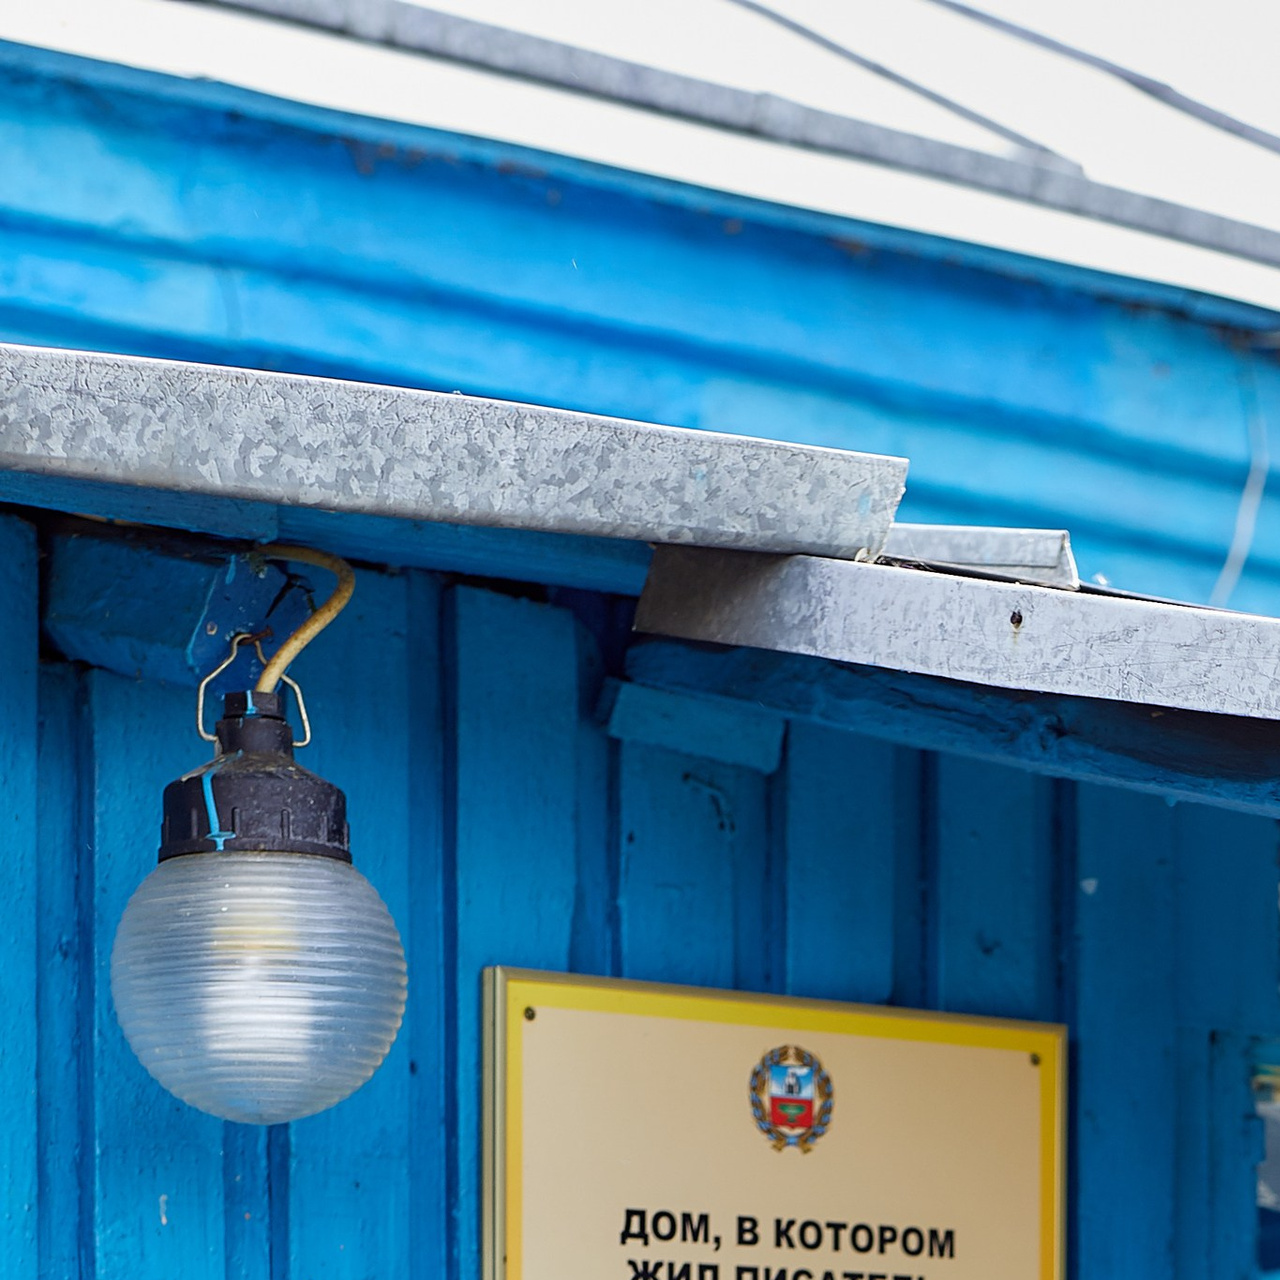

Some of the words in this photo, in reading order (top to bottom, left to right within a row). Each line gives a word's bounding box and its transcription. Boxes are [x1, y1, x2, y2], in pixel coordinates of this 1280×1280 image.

[620, 1208, 721, 1252] ДОМ,
[736, 1215, 760, 1246] В
[774, 1218, 955, 1259] КОТОРОМ
